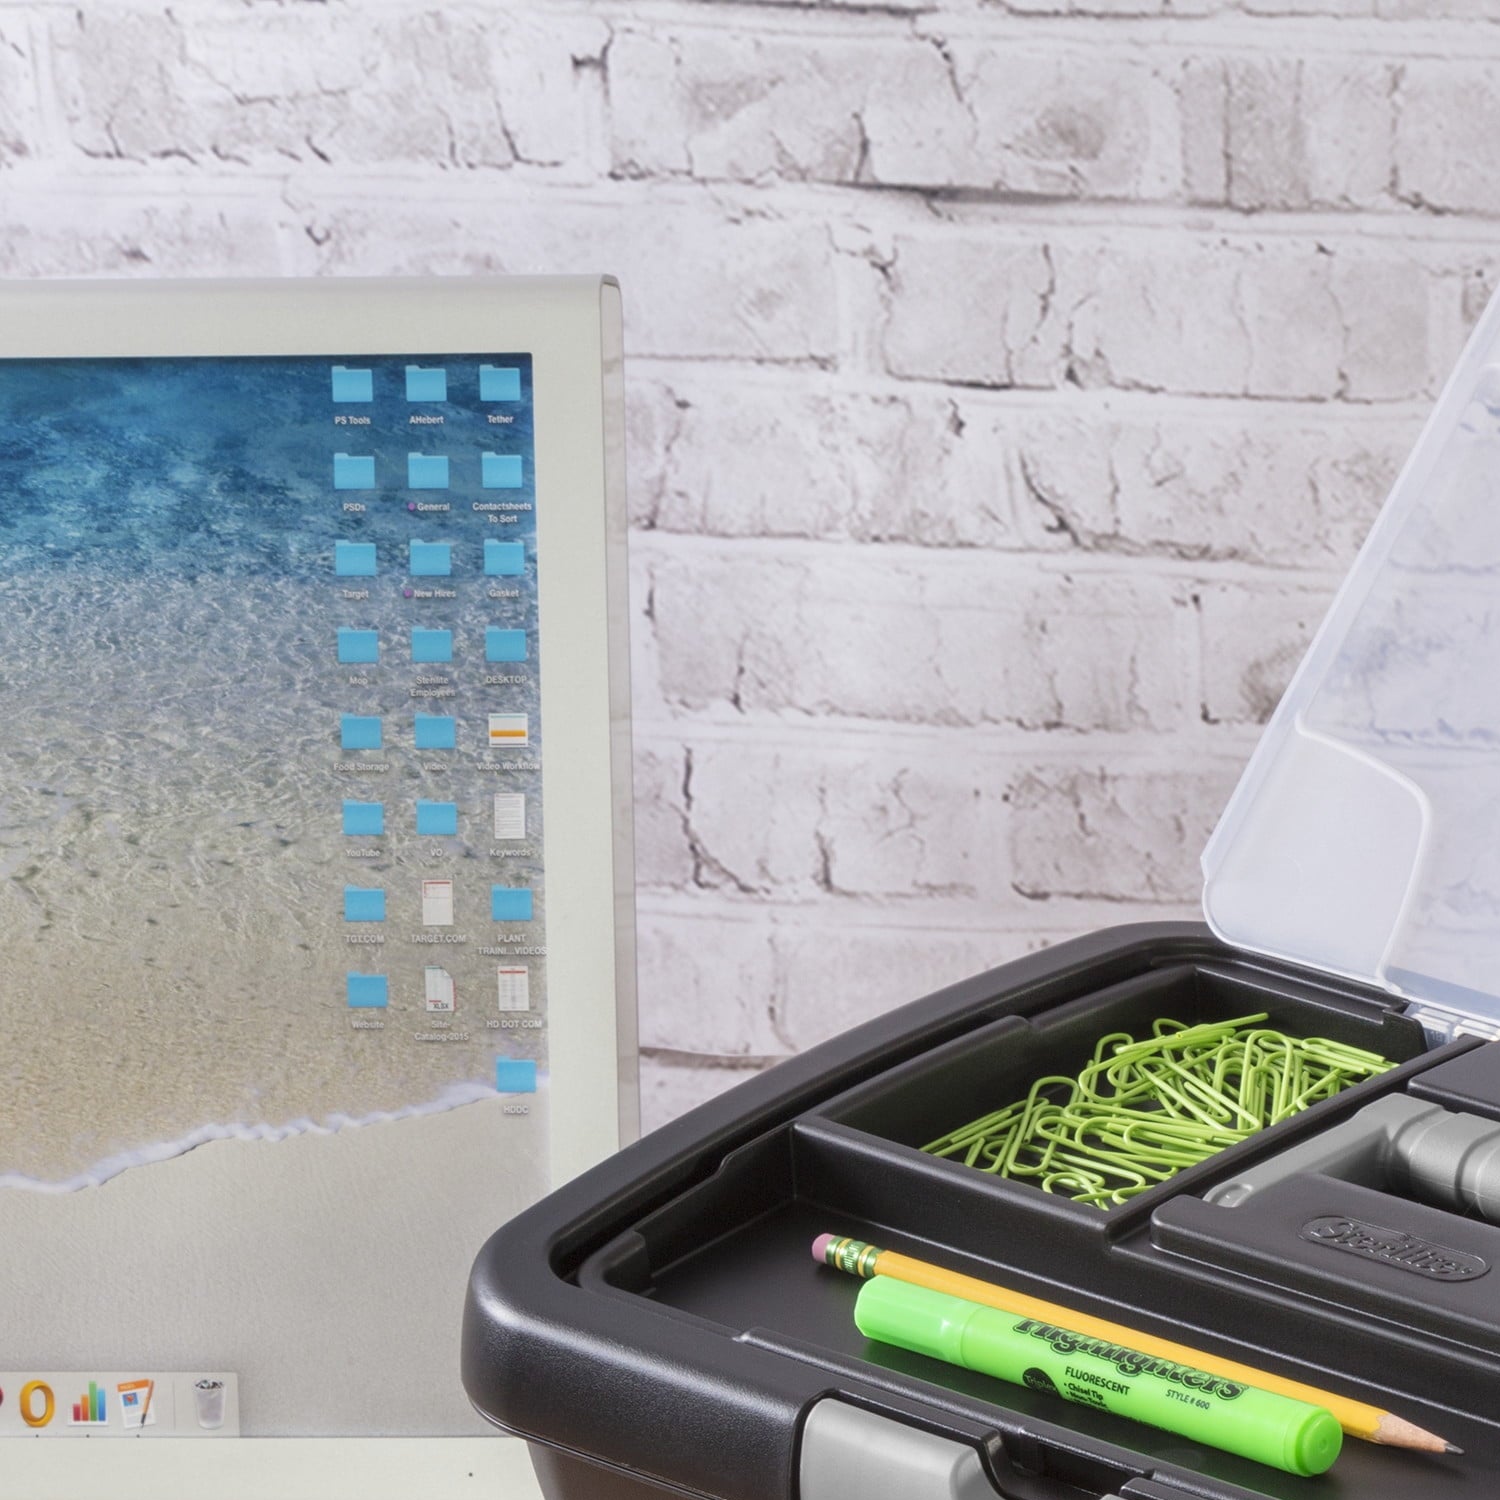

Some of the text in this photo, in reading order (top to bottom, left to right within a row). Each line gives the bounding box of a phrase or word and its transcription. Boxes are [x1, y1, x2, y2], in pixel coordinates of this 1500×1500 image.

[334, 416, 371, 425] PS Tools
[487, 415, 514, 424] Tether
[343, 502, 366, 512] PSDs
[417, 502, 450, 511] General
[472, 502, 532, 511] Contactsheets
[488, 514, 518, 524] To Sort
[343, 589, 369, 600] Target
[489, 589, 520, 598] Gasket
[486, 675, 527, 684] DESKTOP
[357, 763, 390, 772] Storage
[423, 762, 448, 771] Video
[476, 762, 500, 770] Video
[489, 848, 531, 858] Keywords
[411, 934, 467, 943] TARGET.COM
[497, 934, 526, 943] PLANT
[486, 1020, 543, 1029] HD DOT COM
[1309, 1222, 1462, 1275] Sterilite
[1065, 1366, 1131, 1395] FLUORESCENT
[1068, 1382, 1104, 1401] Chisel Tip
[1165, 1389, 1189, 1403] STYLE
[1195, 1399, 1211, 1410] 600
